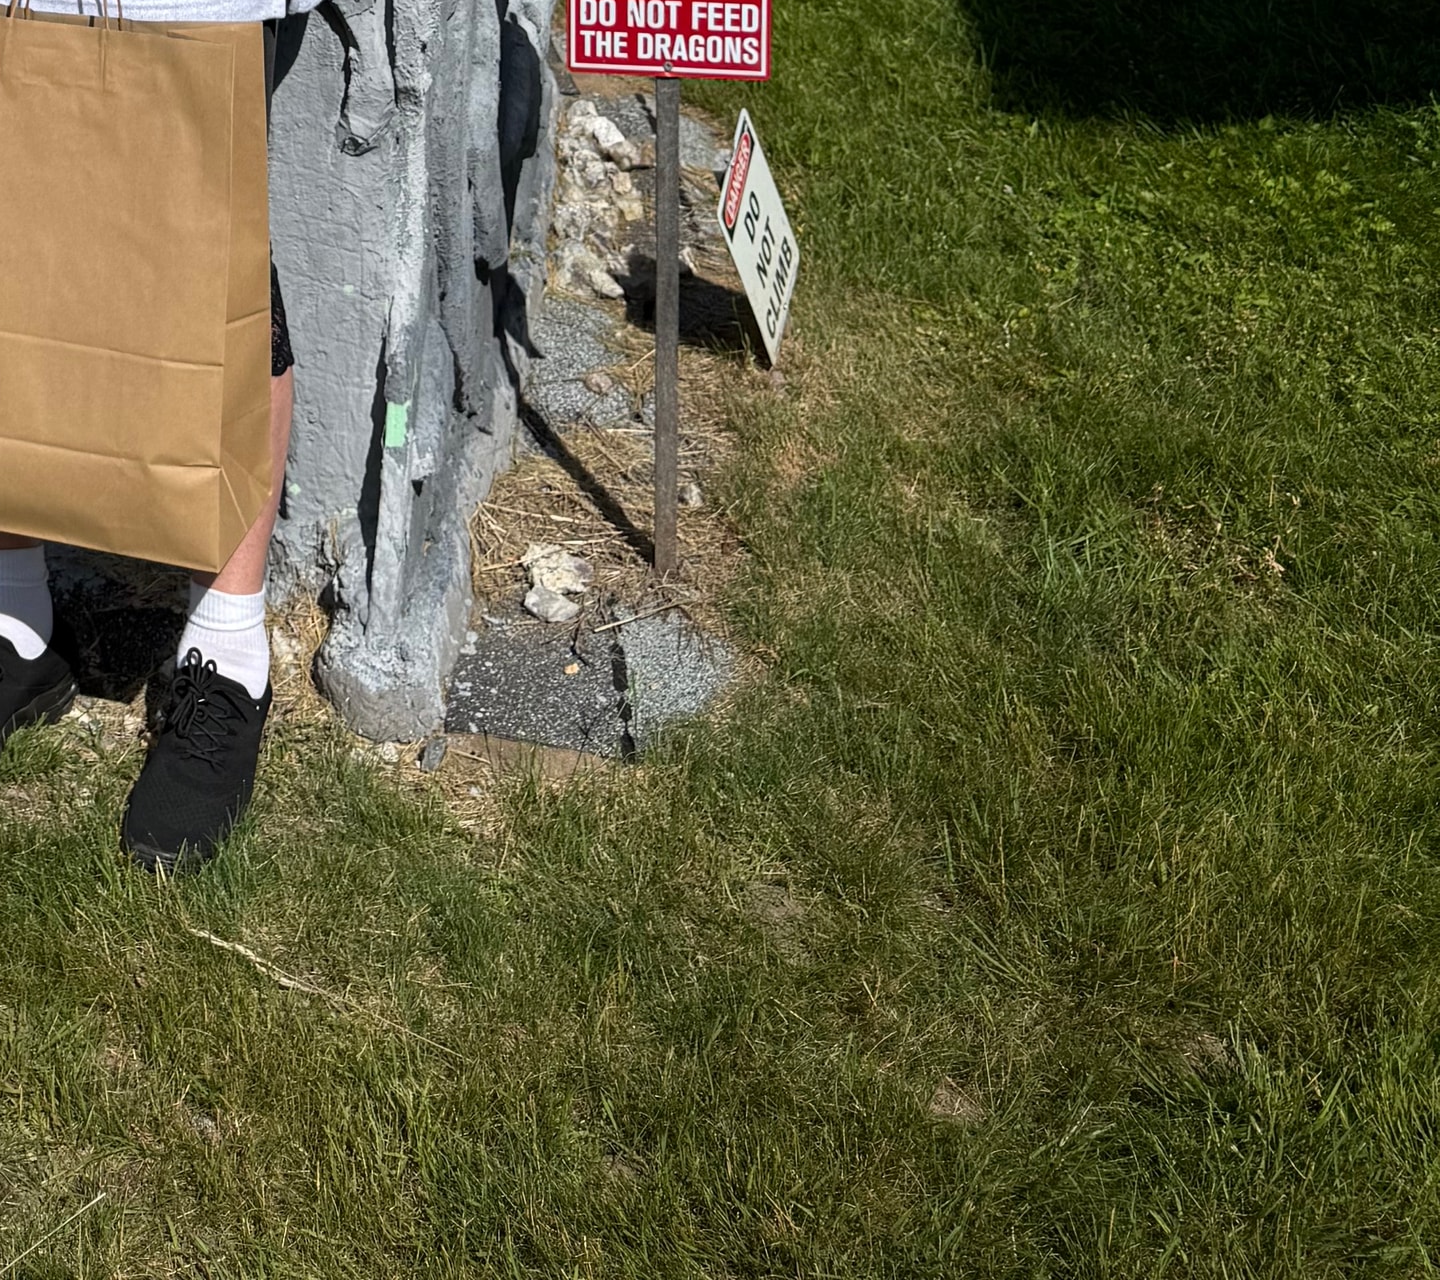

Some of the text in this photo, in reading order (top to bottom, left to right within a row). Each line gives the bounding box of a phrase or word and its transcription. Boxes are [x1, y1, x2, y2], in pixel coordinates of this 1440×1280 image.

[579, 30, 759, 65] THE DRAGONS
[691, 1, 759, 33] FEED
[726, 133, 751, 221] DANGER
[744, 190, 760, 244] DO
[756, 215, 776, 289] NOT
[766, 236, 793, 339] CLIMB
